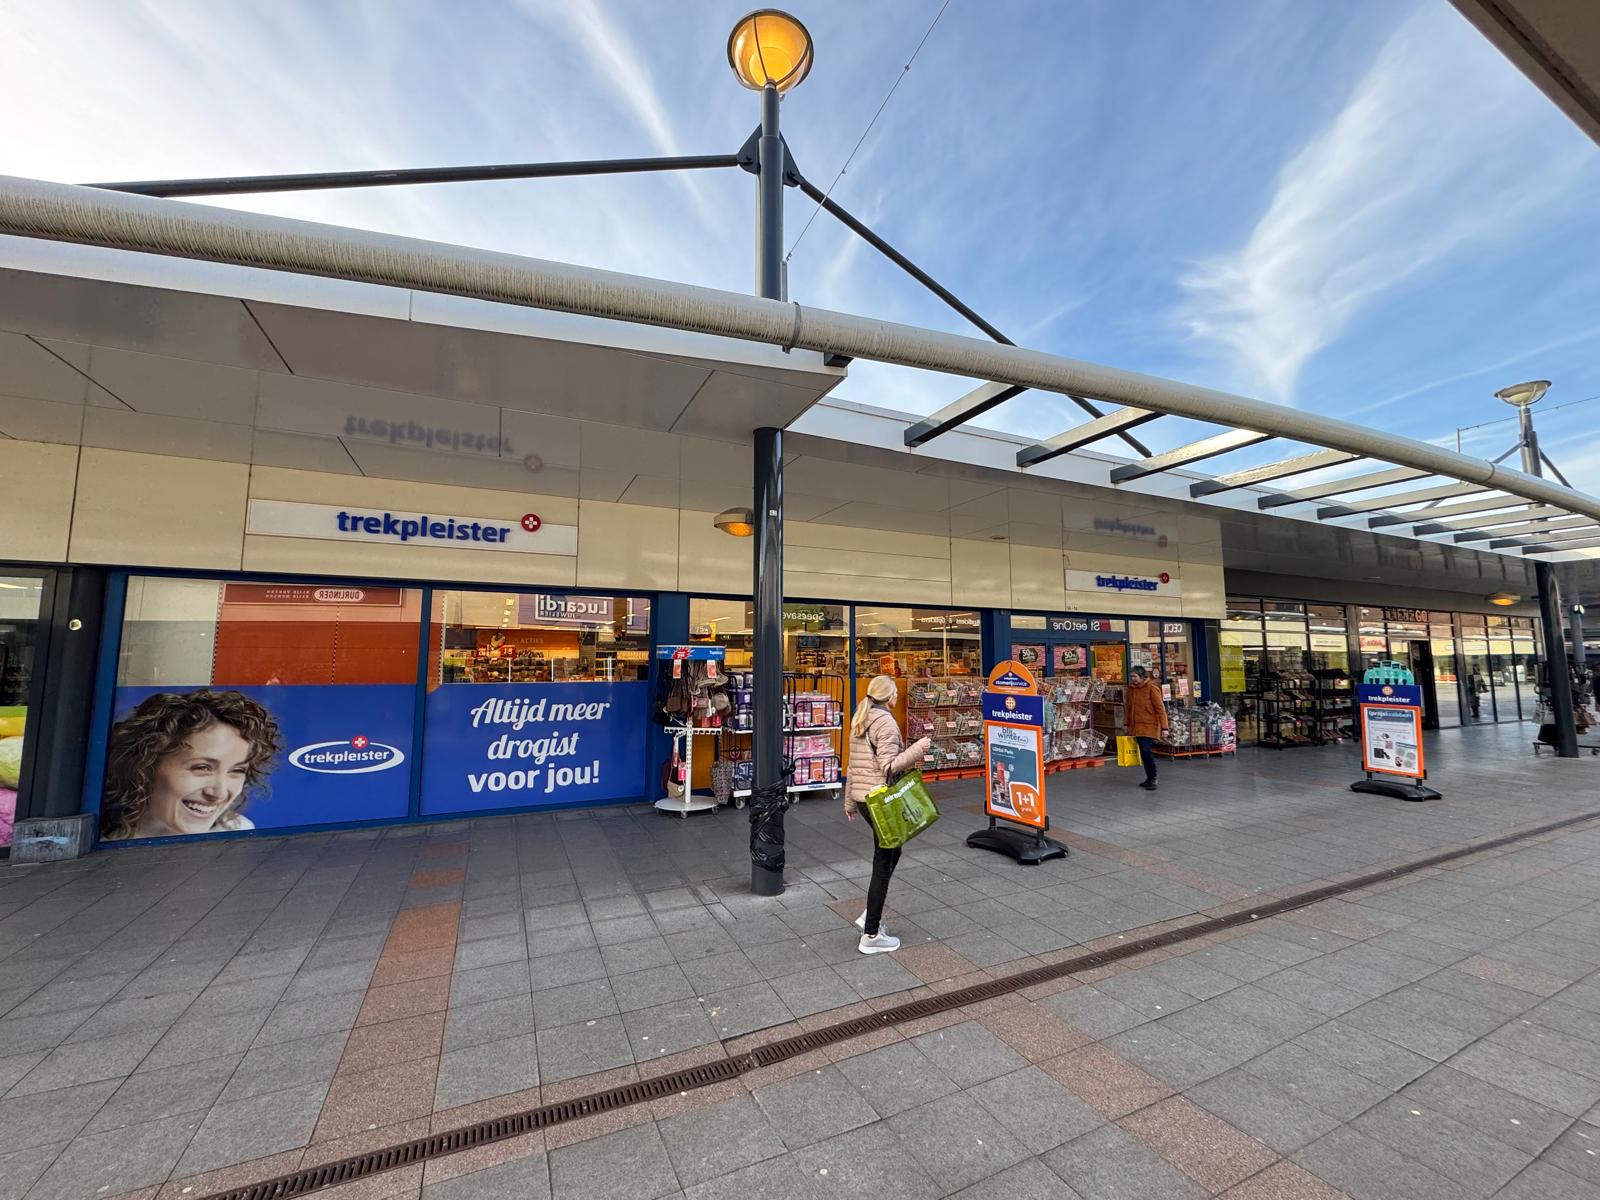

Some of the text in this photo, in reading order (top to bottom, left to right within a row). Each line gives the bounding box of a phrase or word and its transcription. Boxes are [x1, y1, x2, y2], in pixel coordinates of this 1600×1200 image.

[336, 510, 510, 543] trekpleister
[1095, 575, 1158, 592] trekpleister
[1368, 695, 1411, 703] trekpleister
[471, 698, 610, 729] Altijd meer
[992, 710, 1032, 720] trekpleister
[304, 746, 390, 765] trekpleister
[487, 732, 579, 764] drogist
[468, 761, 599, 794] voor jou!
[1016, 791, 1035, 807] 1+1
